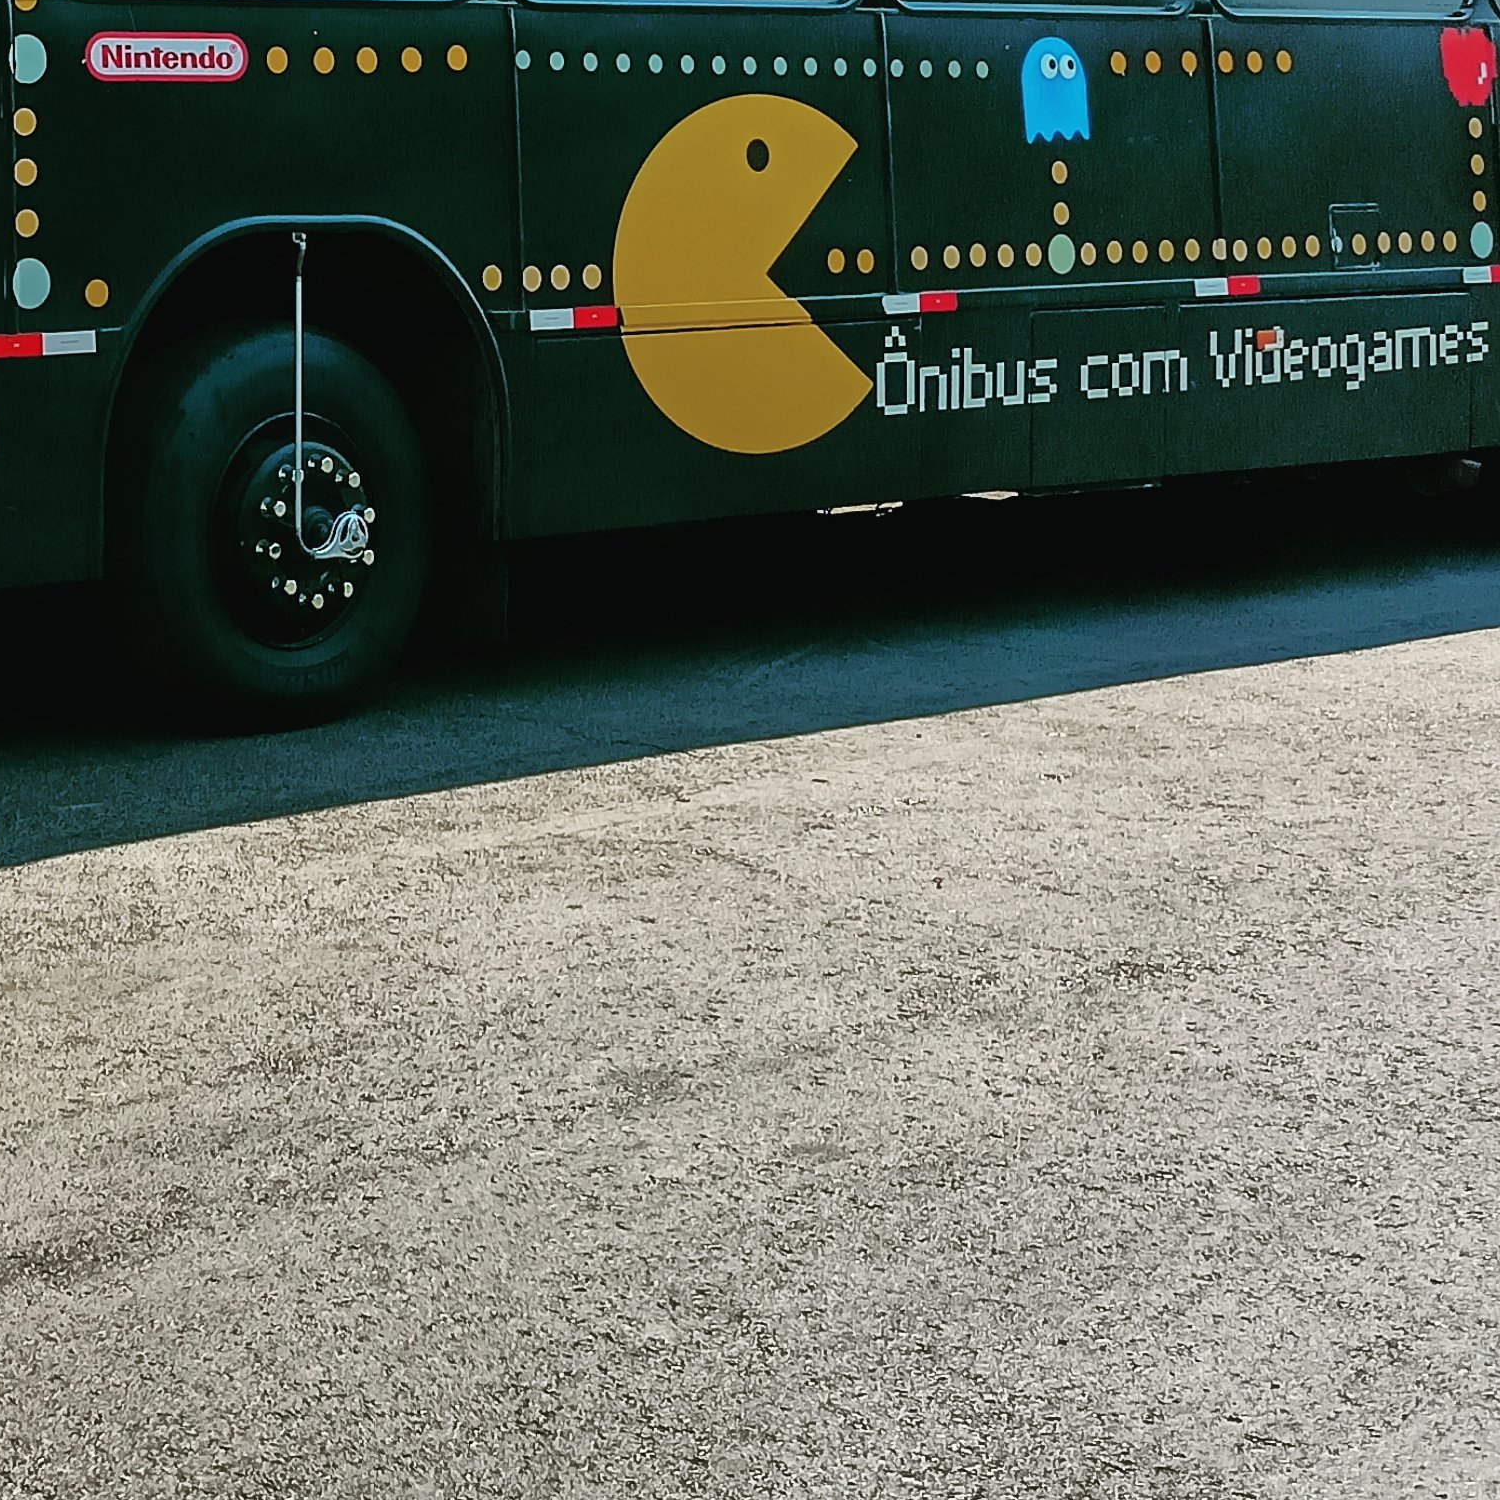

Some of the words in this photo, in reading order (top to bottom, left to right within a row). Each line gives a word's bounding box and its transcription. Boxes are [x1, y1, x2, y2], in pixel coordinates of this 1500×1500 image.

[876, 326, 1058, 416] Ônibus
[1080, 350, 1188, 399] com
[1209, 320, 1489, 391] Videogames
